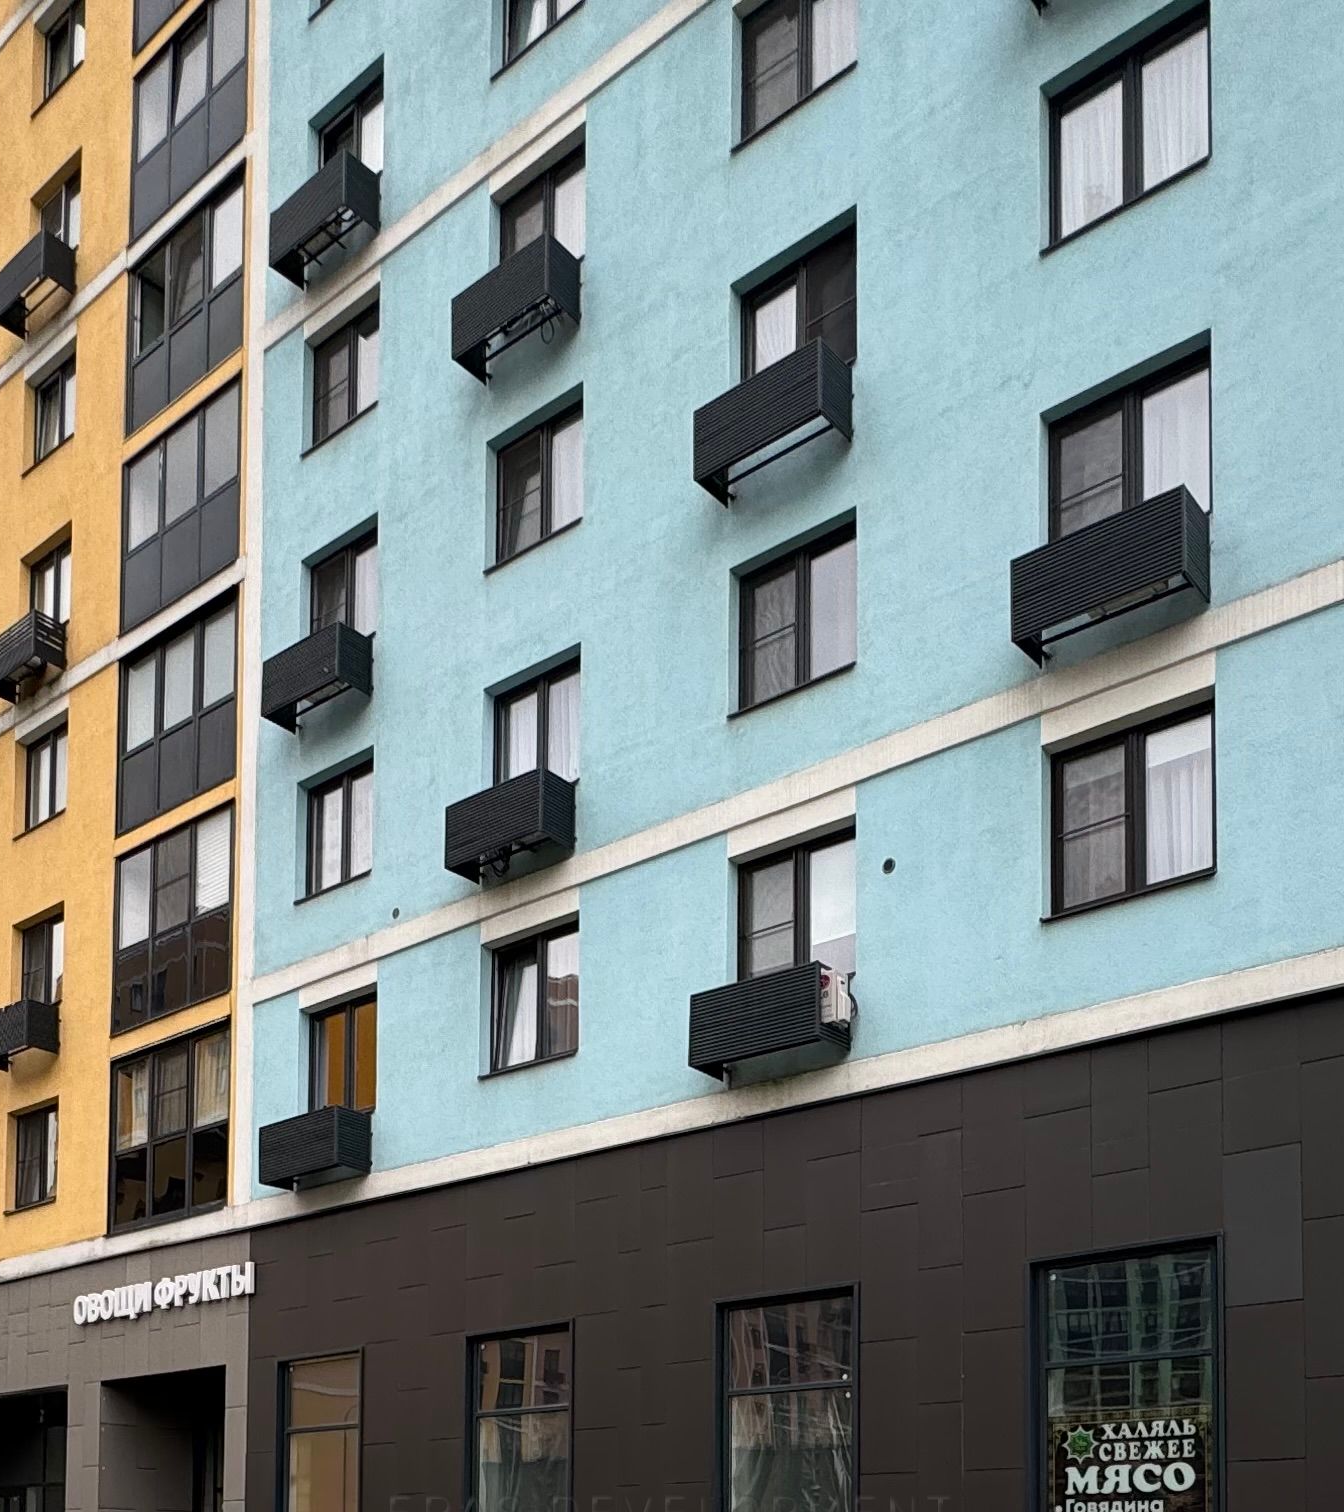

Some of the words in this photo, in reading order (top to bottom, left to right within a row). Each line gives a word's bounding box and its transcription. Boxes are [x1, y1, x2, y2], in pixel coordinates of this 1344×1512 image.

[73, 1281, 153, 1326] ОВОЩИ
[154, 1260, 256, 1310] ФРУКТЫ
[1100, 1418, 1197, 1441] ХАЛЯЛЬ
[1098, 1438, 1196, 1462] СВЕЖЕЕ
[1064, 1461, 1197, 1496] МЯСО
